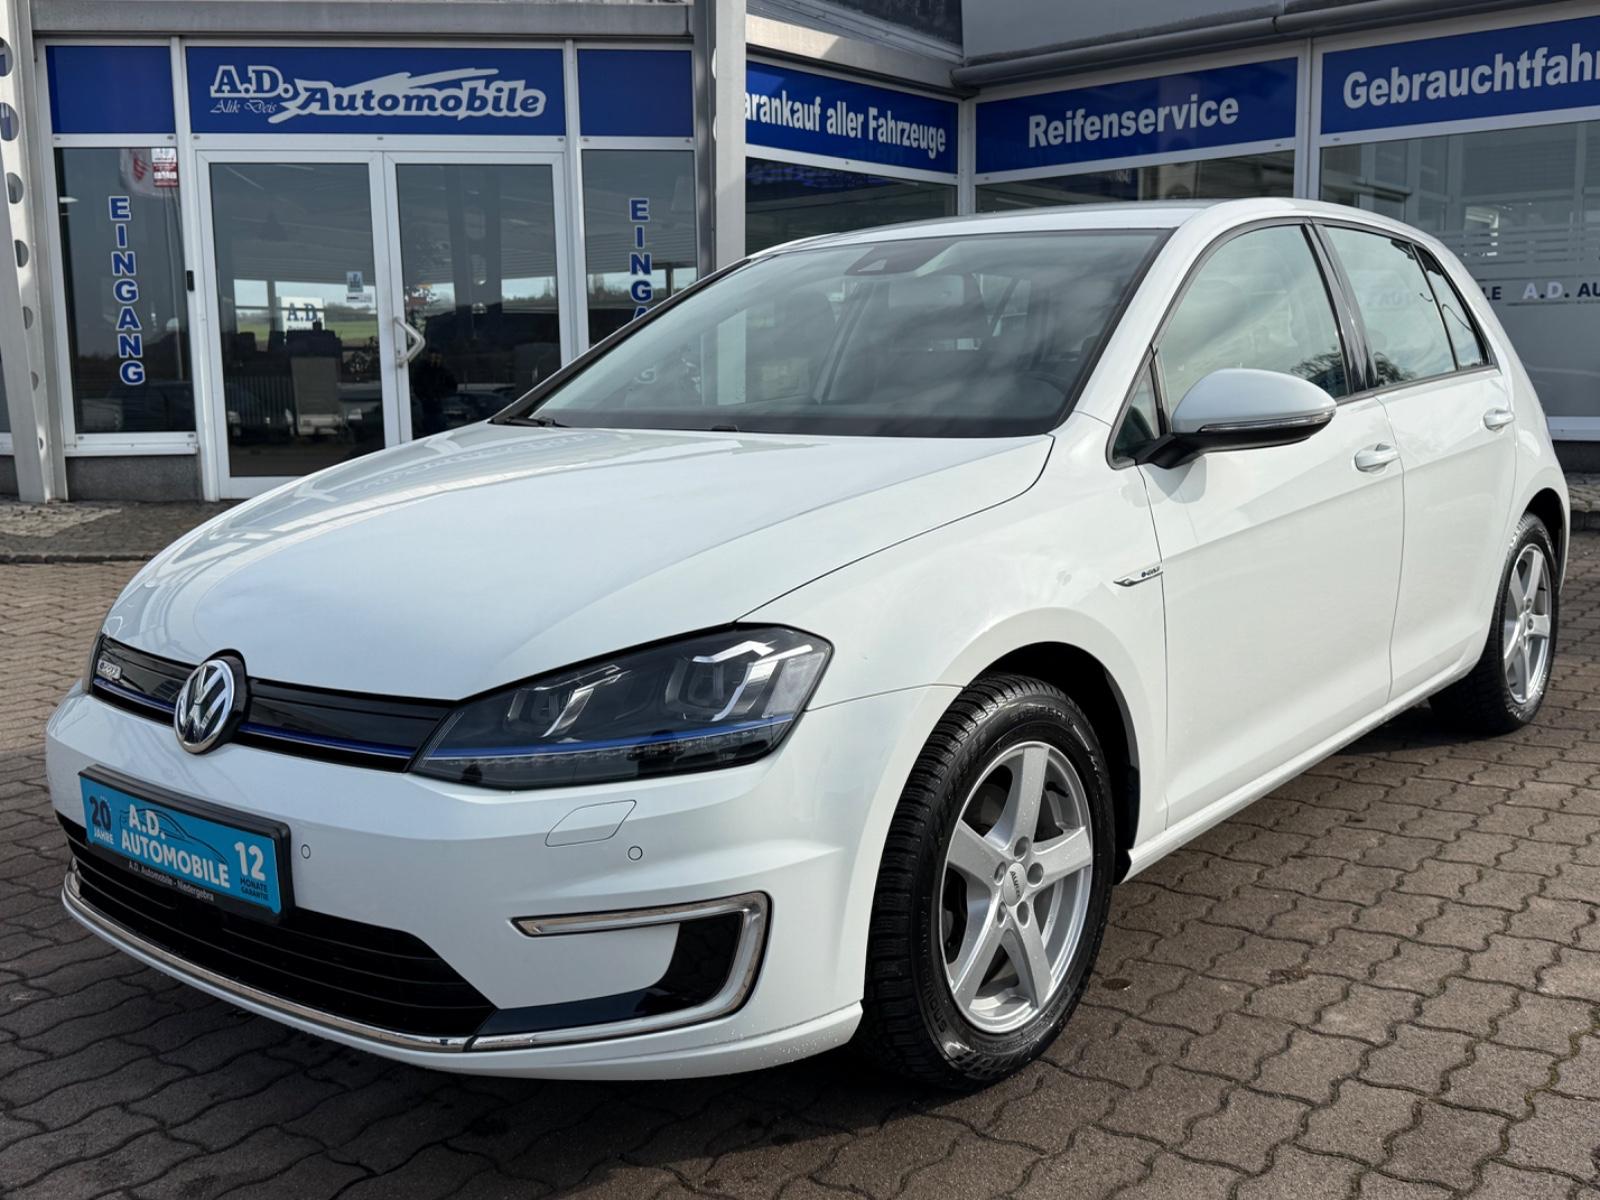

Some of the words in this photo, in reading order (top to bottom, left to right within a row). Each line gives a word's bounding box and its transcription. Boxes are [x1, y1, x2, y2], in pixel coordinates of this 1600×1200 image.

[210, 65, 294, 98] A.D.
[297, 79, 547, 118] Automobile
[826, 101, 865, 139] aller
[868, 106, 946, 160] Fahrzeuge
[1028, 93, 1239, 148] Reifenservice
[109, 196, 146, 385] EINGANG
[1522, 281, 1570, 300] A.D.
[89, 796, 112, 831] 20
[129, 804, 166, 840] A.D.
[121, 830, 231, 888] AUTOMOBILE
[234, 841, 266, 881] 12
